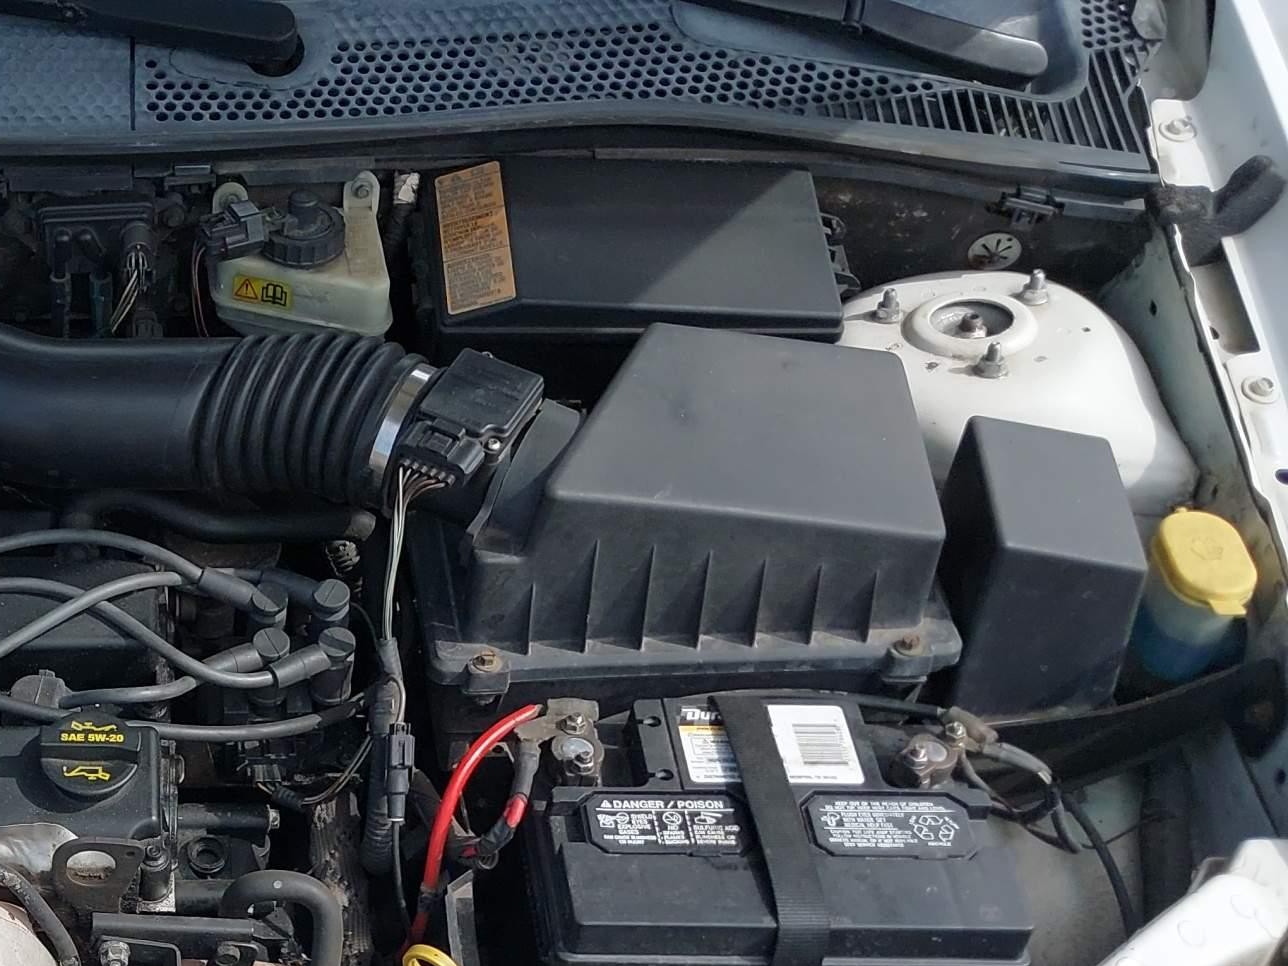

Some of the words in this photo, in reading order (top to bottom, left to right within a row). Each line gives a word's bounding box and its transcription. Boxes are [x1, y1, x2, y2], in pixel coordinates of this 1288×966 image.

[60, 733, 85, 742] SAE
[88, 733, 124, 743] 5W-20
[613, 800, 664, 809] DANGER
[677, 800, 724, 809] POISON
